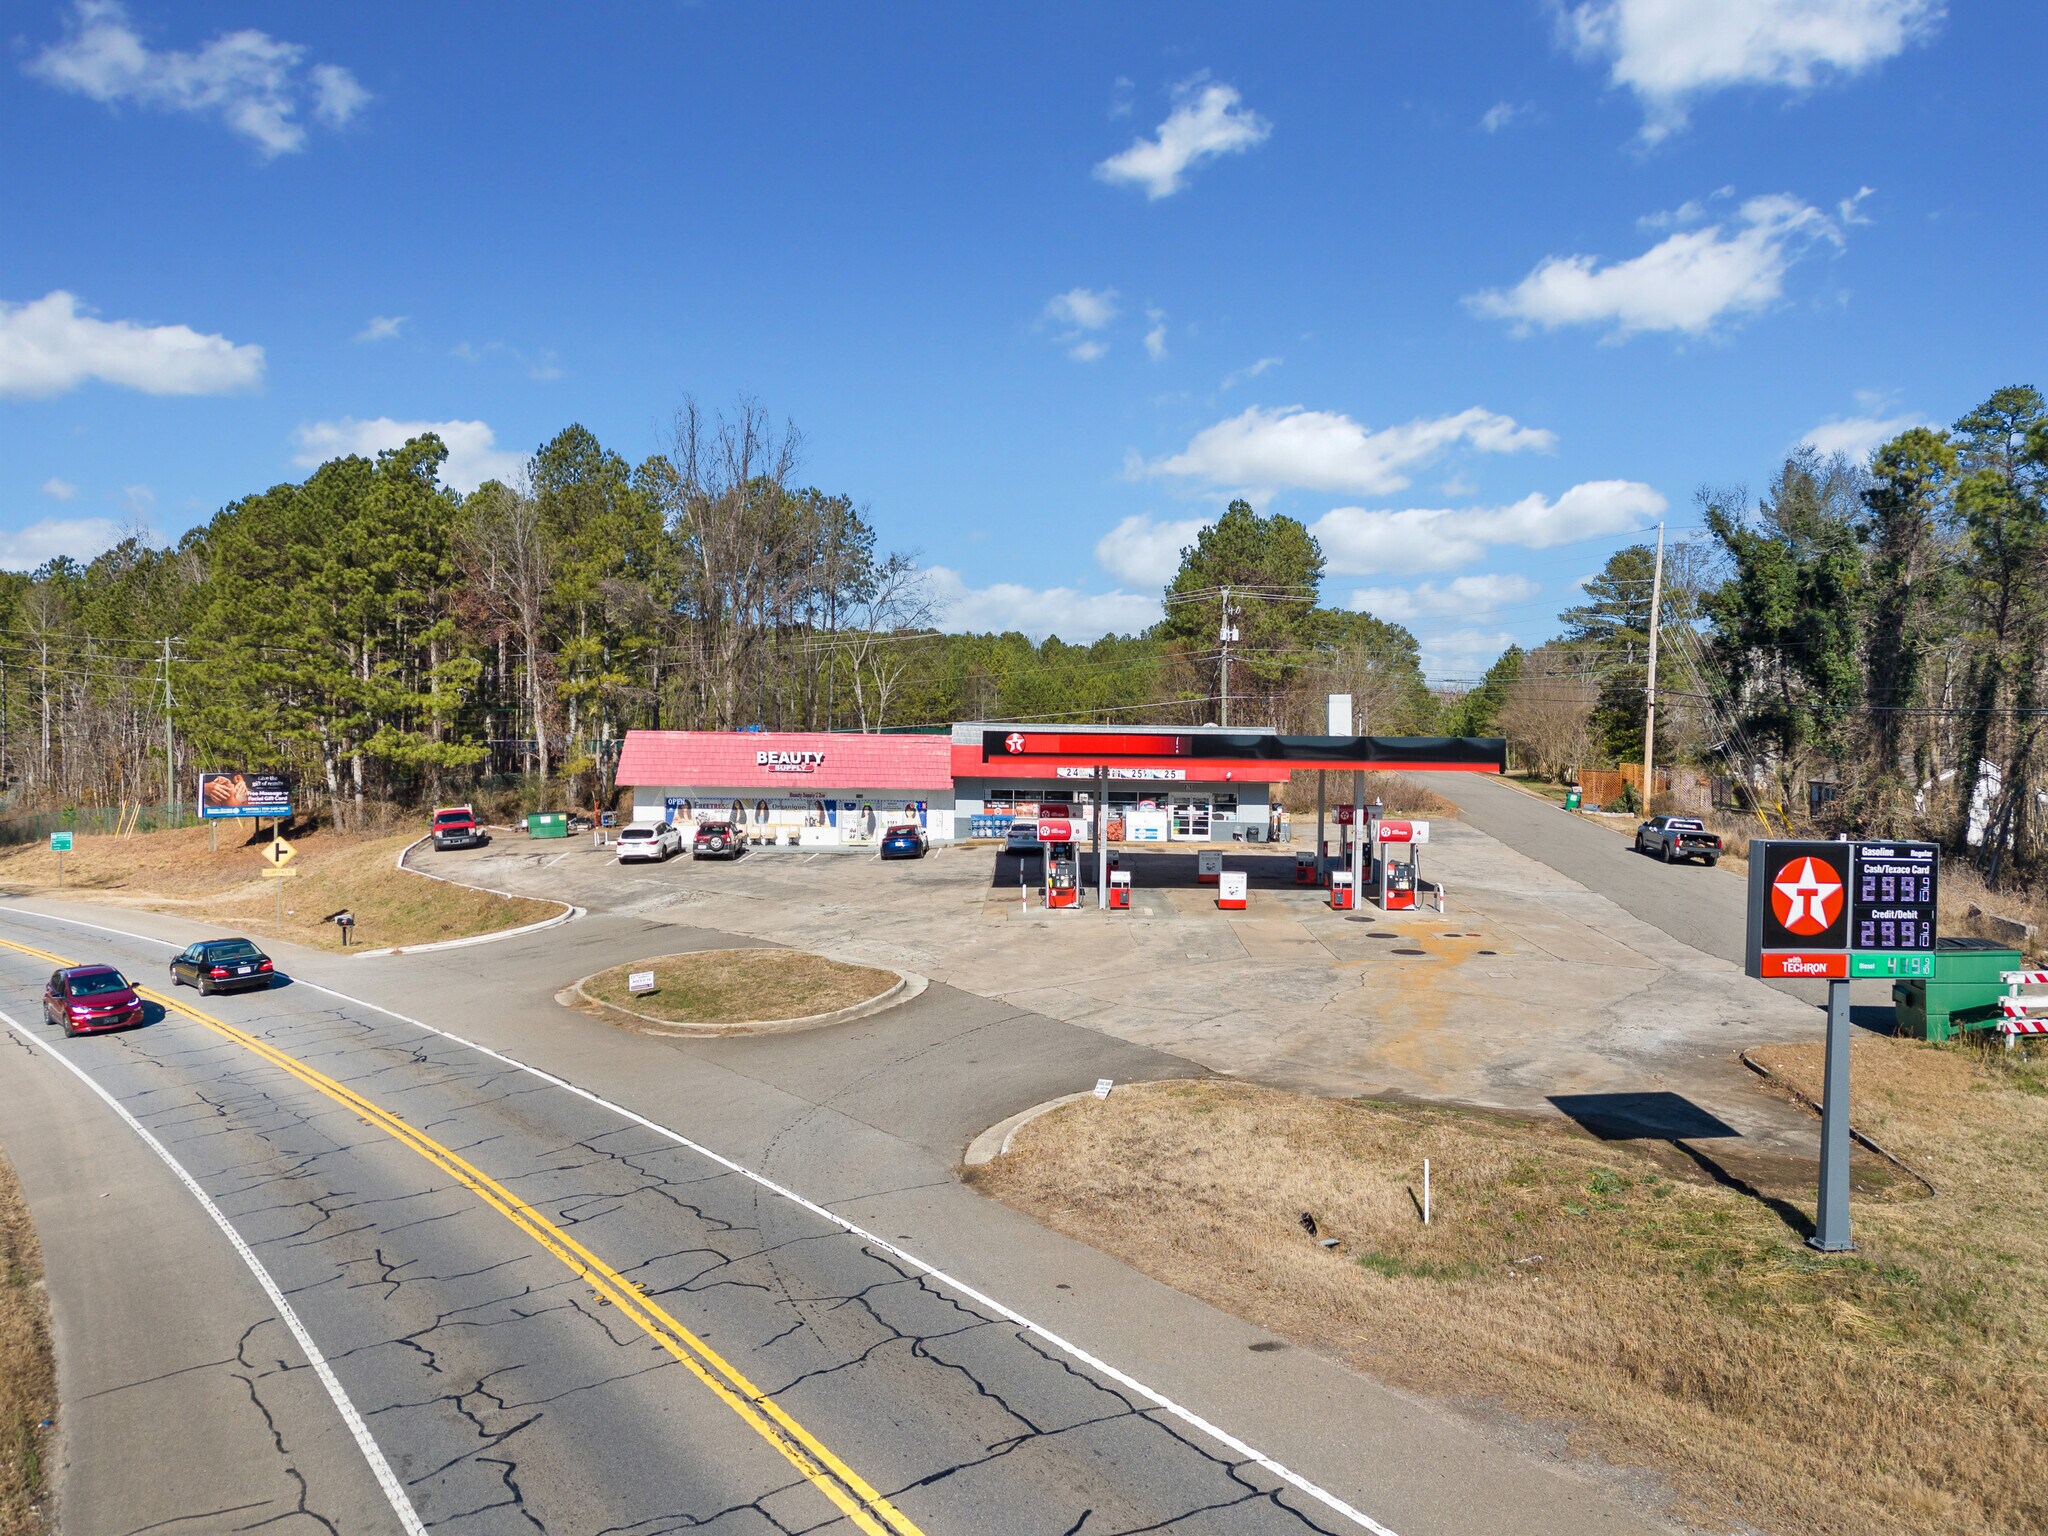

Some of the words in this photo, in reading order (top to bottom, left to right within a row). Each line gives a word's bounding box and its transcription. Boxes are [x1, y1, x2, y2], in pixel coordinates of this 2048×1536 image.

[757, 751, 824, 765] BEAUTY
[1164, 770, 1176, 778] 25
[1862, 847, 1894, 856] Gasoline
[1910, 850, 1933, 858] Regular
[1864, 864, 1910, 874] Cash/Texaco
[1911, 865, 1930, 874] Card
[1871, 910, 1918, 919] Credit/Debit
[1782, 962, 1827, 975] TECHRON
